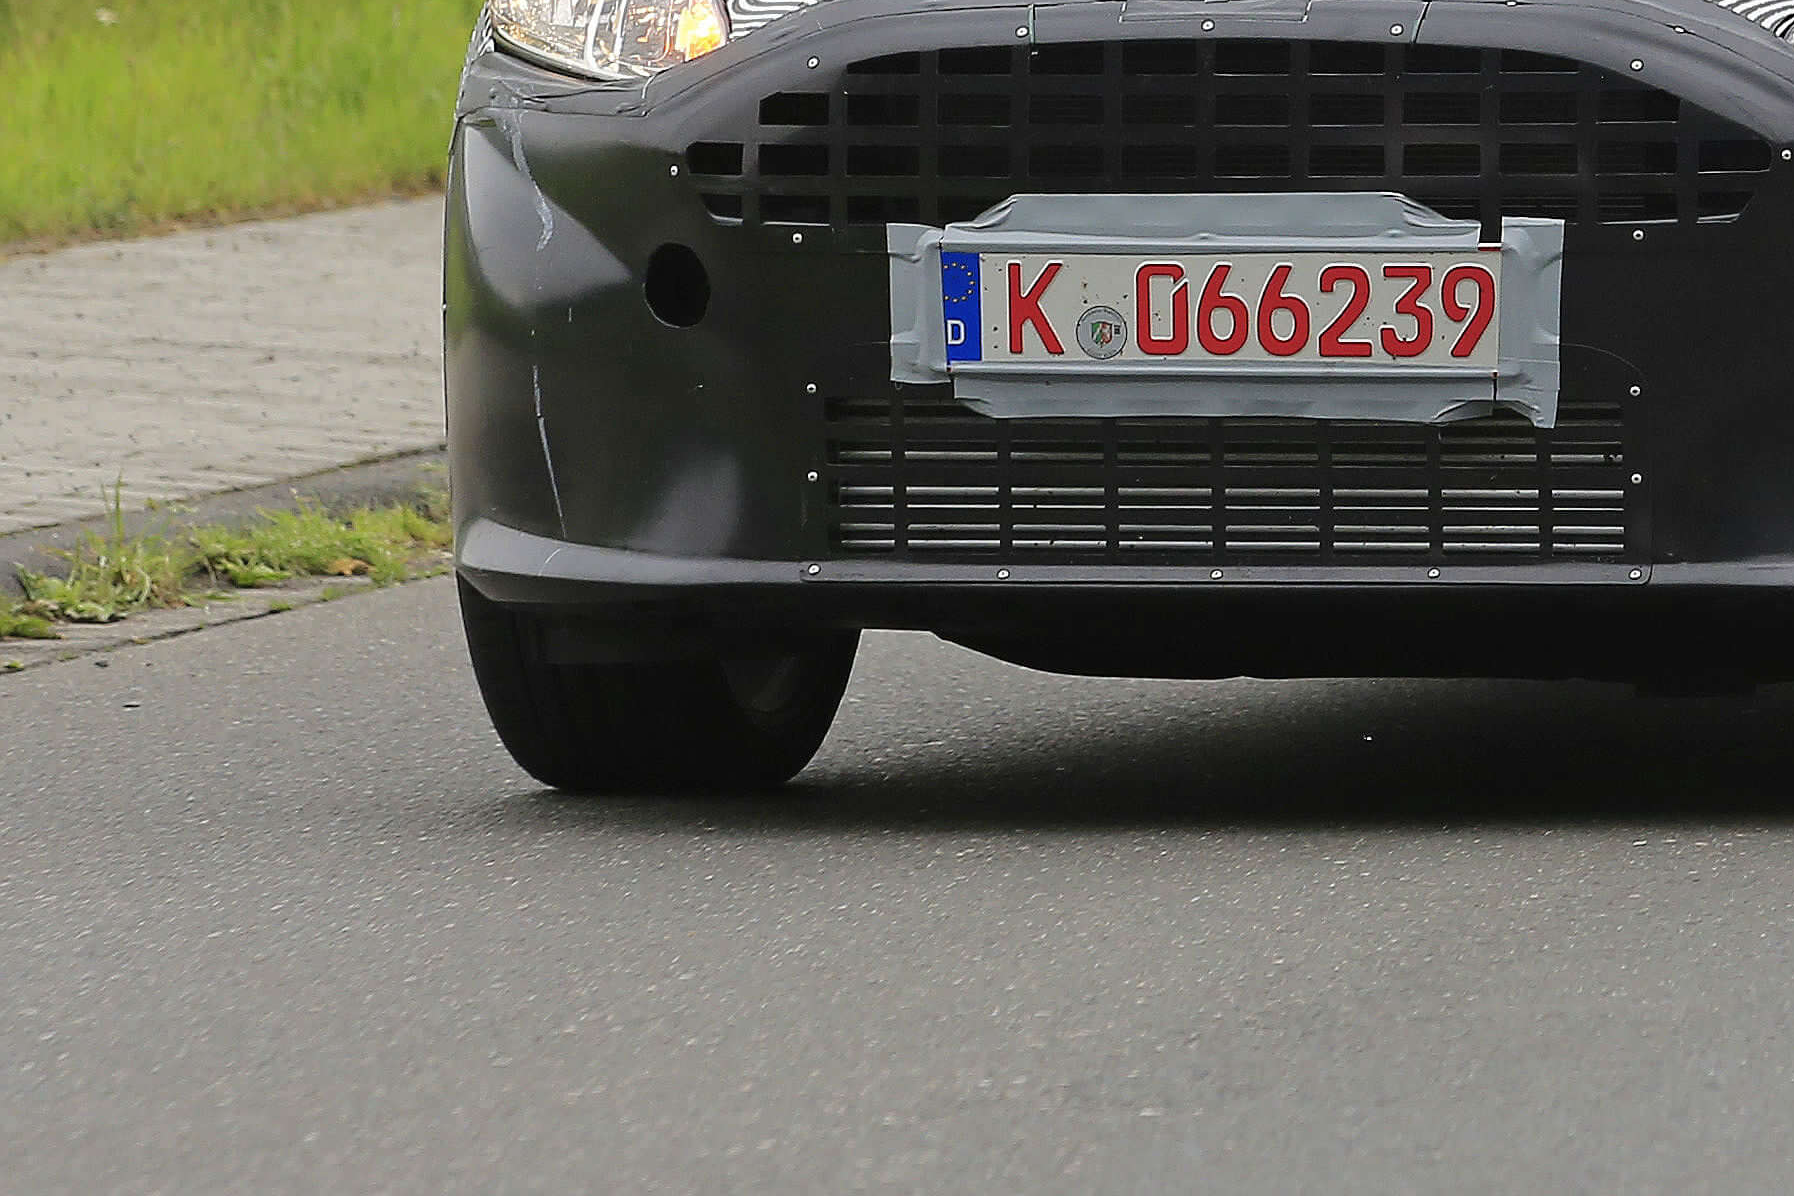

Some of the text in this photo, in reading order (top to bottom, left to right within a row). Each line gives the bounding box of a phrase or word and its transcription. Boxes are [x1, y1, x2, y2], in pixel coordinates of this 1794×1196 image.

[946, 319, 966, 345] D
[1007, 260, 1064, 354] K
[1135, 261, 1496, 357] 066239
